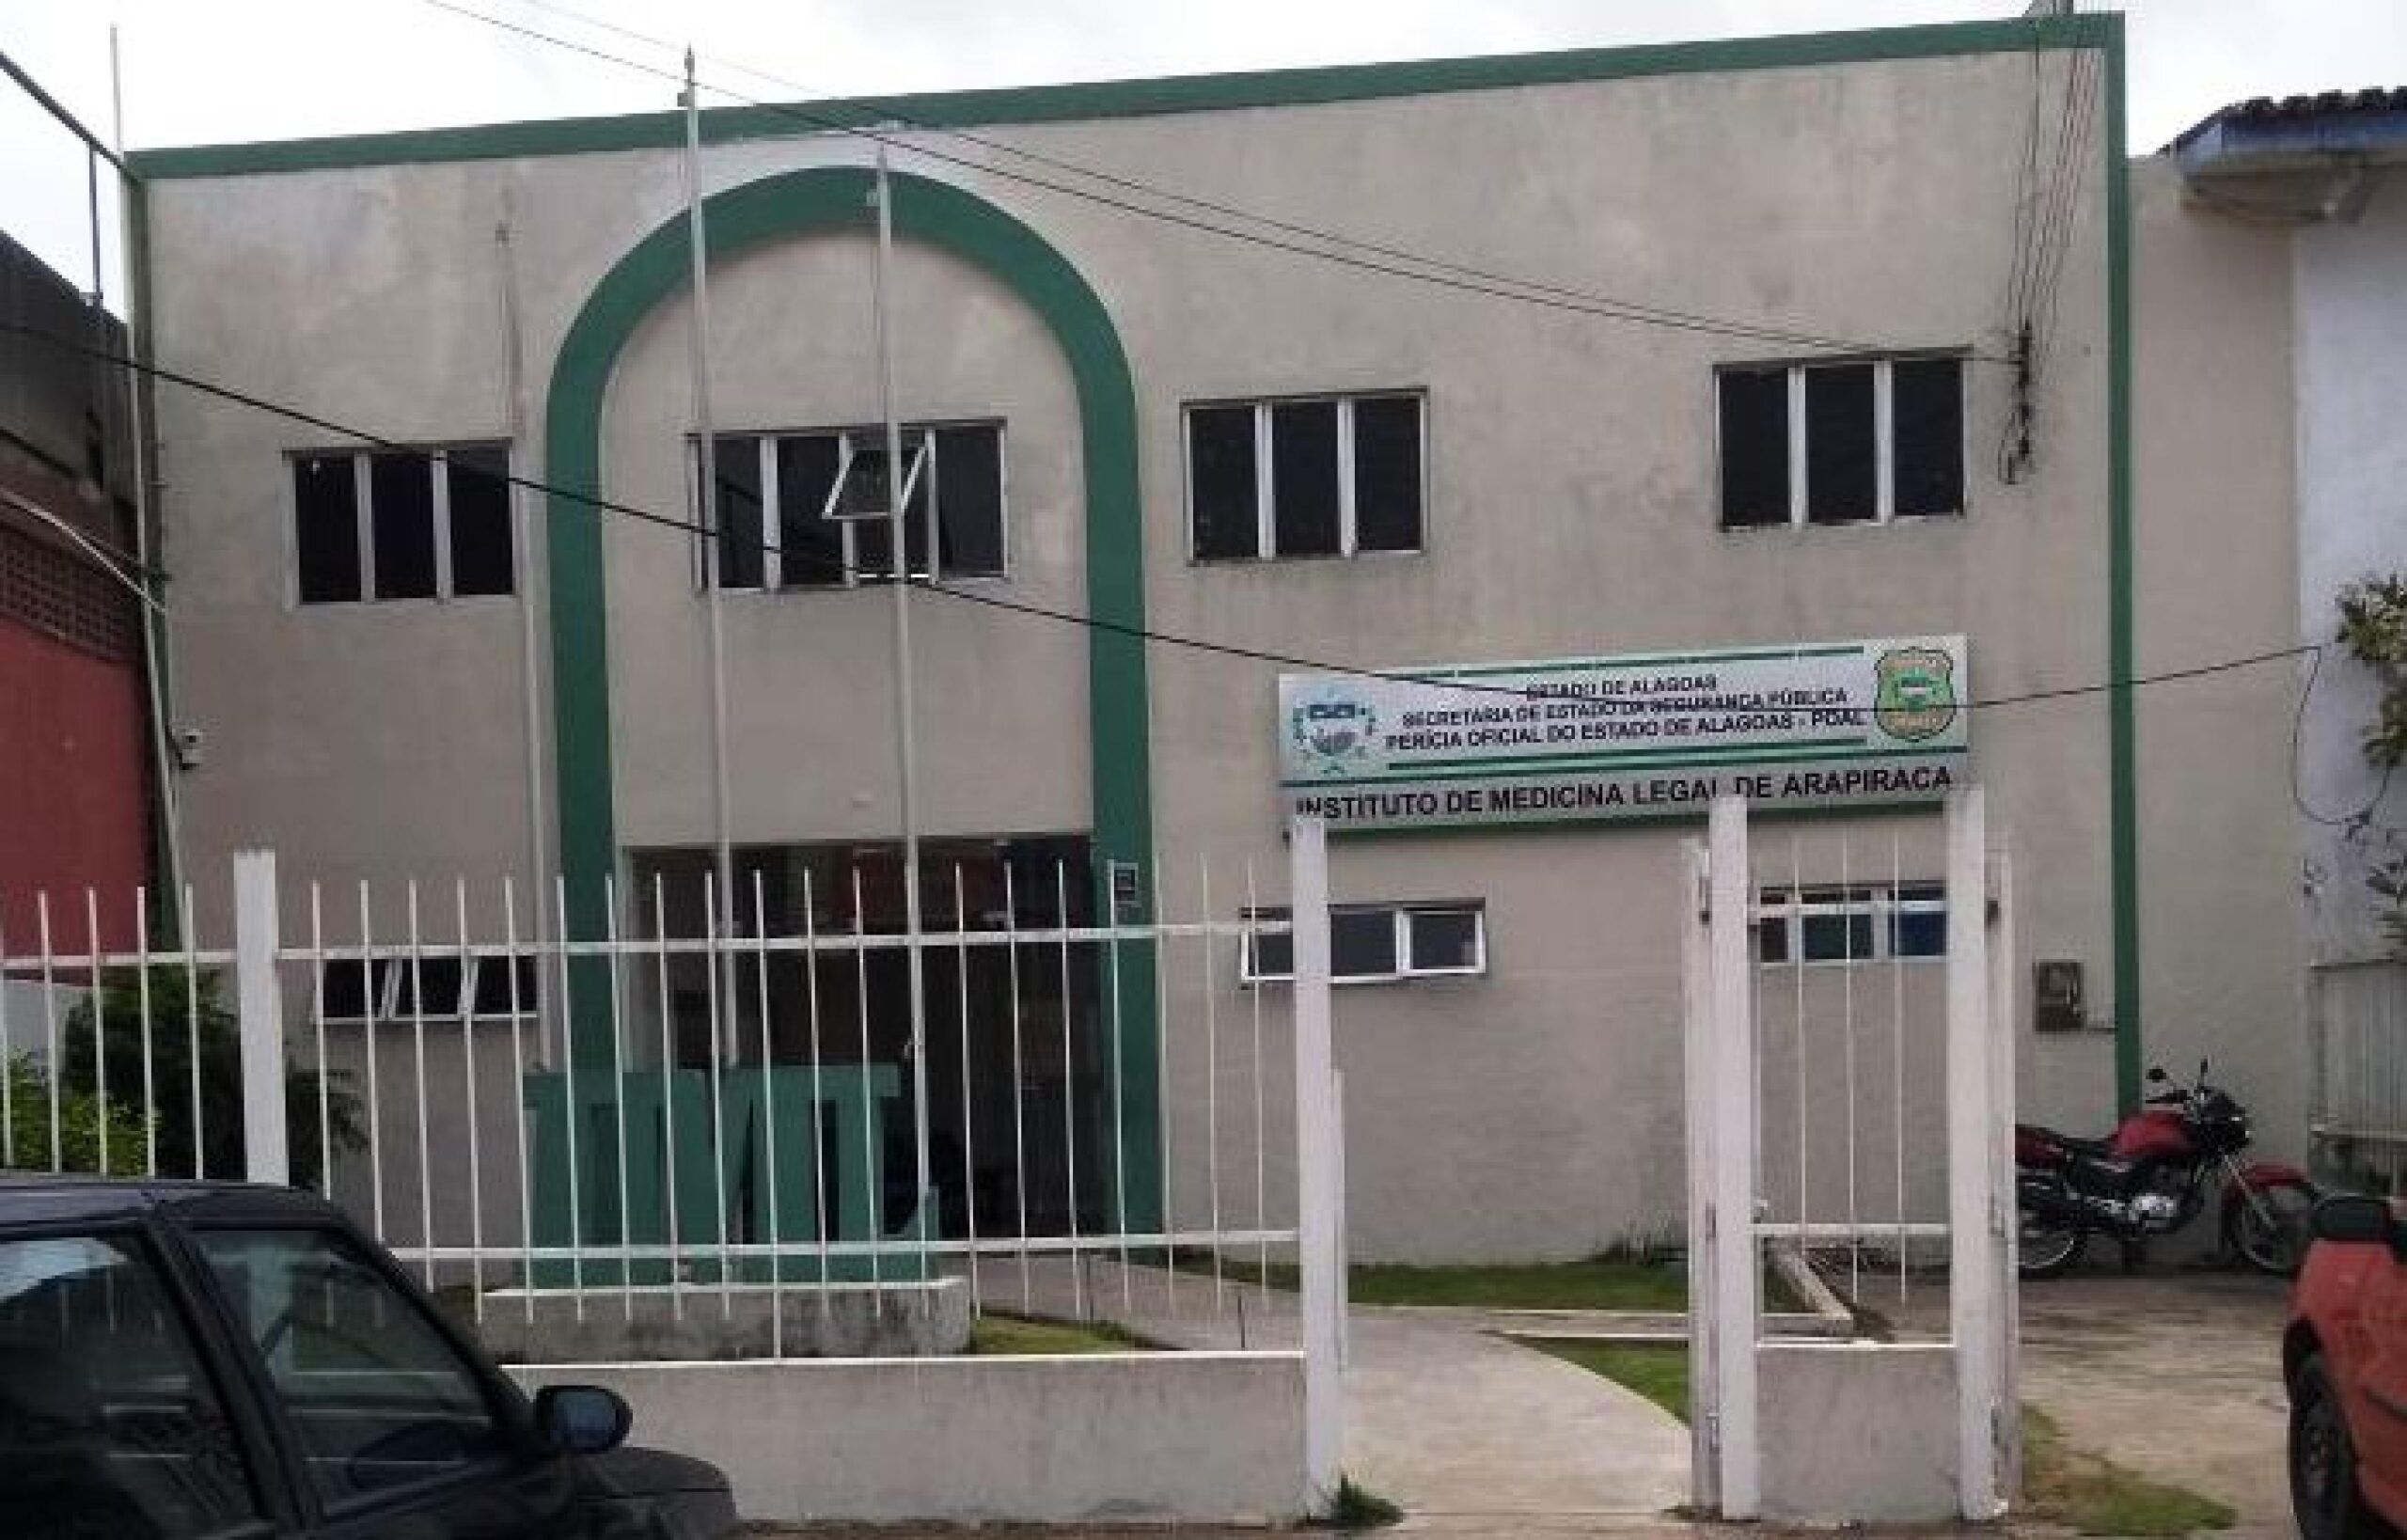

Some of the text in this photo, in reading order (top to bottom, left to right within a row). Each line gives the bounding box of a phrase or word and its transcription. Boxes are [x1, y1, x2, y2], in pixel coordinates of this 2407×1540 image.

[1468, 727, 1544, 746] OFICIAL
[1547, 724, 1576, 743] DO
[1581, 720, 1659, 741] ESTADO
[1663, 717, 1692, 736] DE
[1695, 711, 1792, 733] ALAGOAS
[1295, 794, 1439, 820] INSTITUTO
[1447, 790, 1484, 812] DE
[1488, 782, 1625, 811] MEDICINA
[1734, 775, 1772, 799] DE
[1782, 765, 1953, 797] ARAPIRACA
